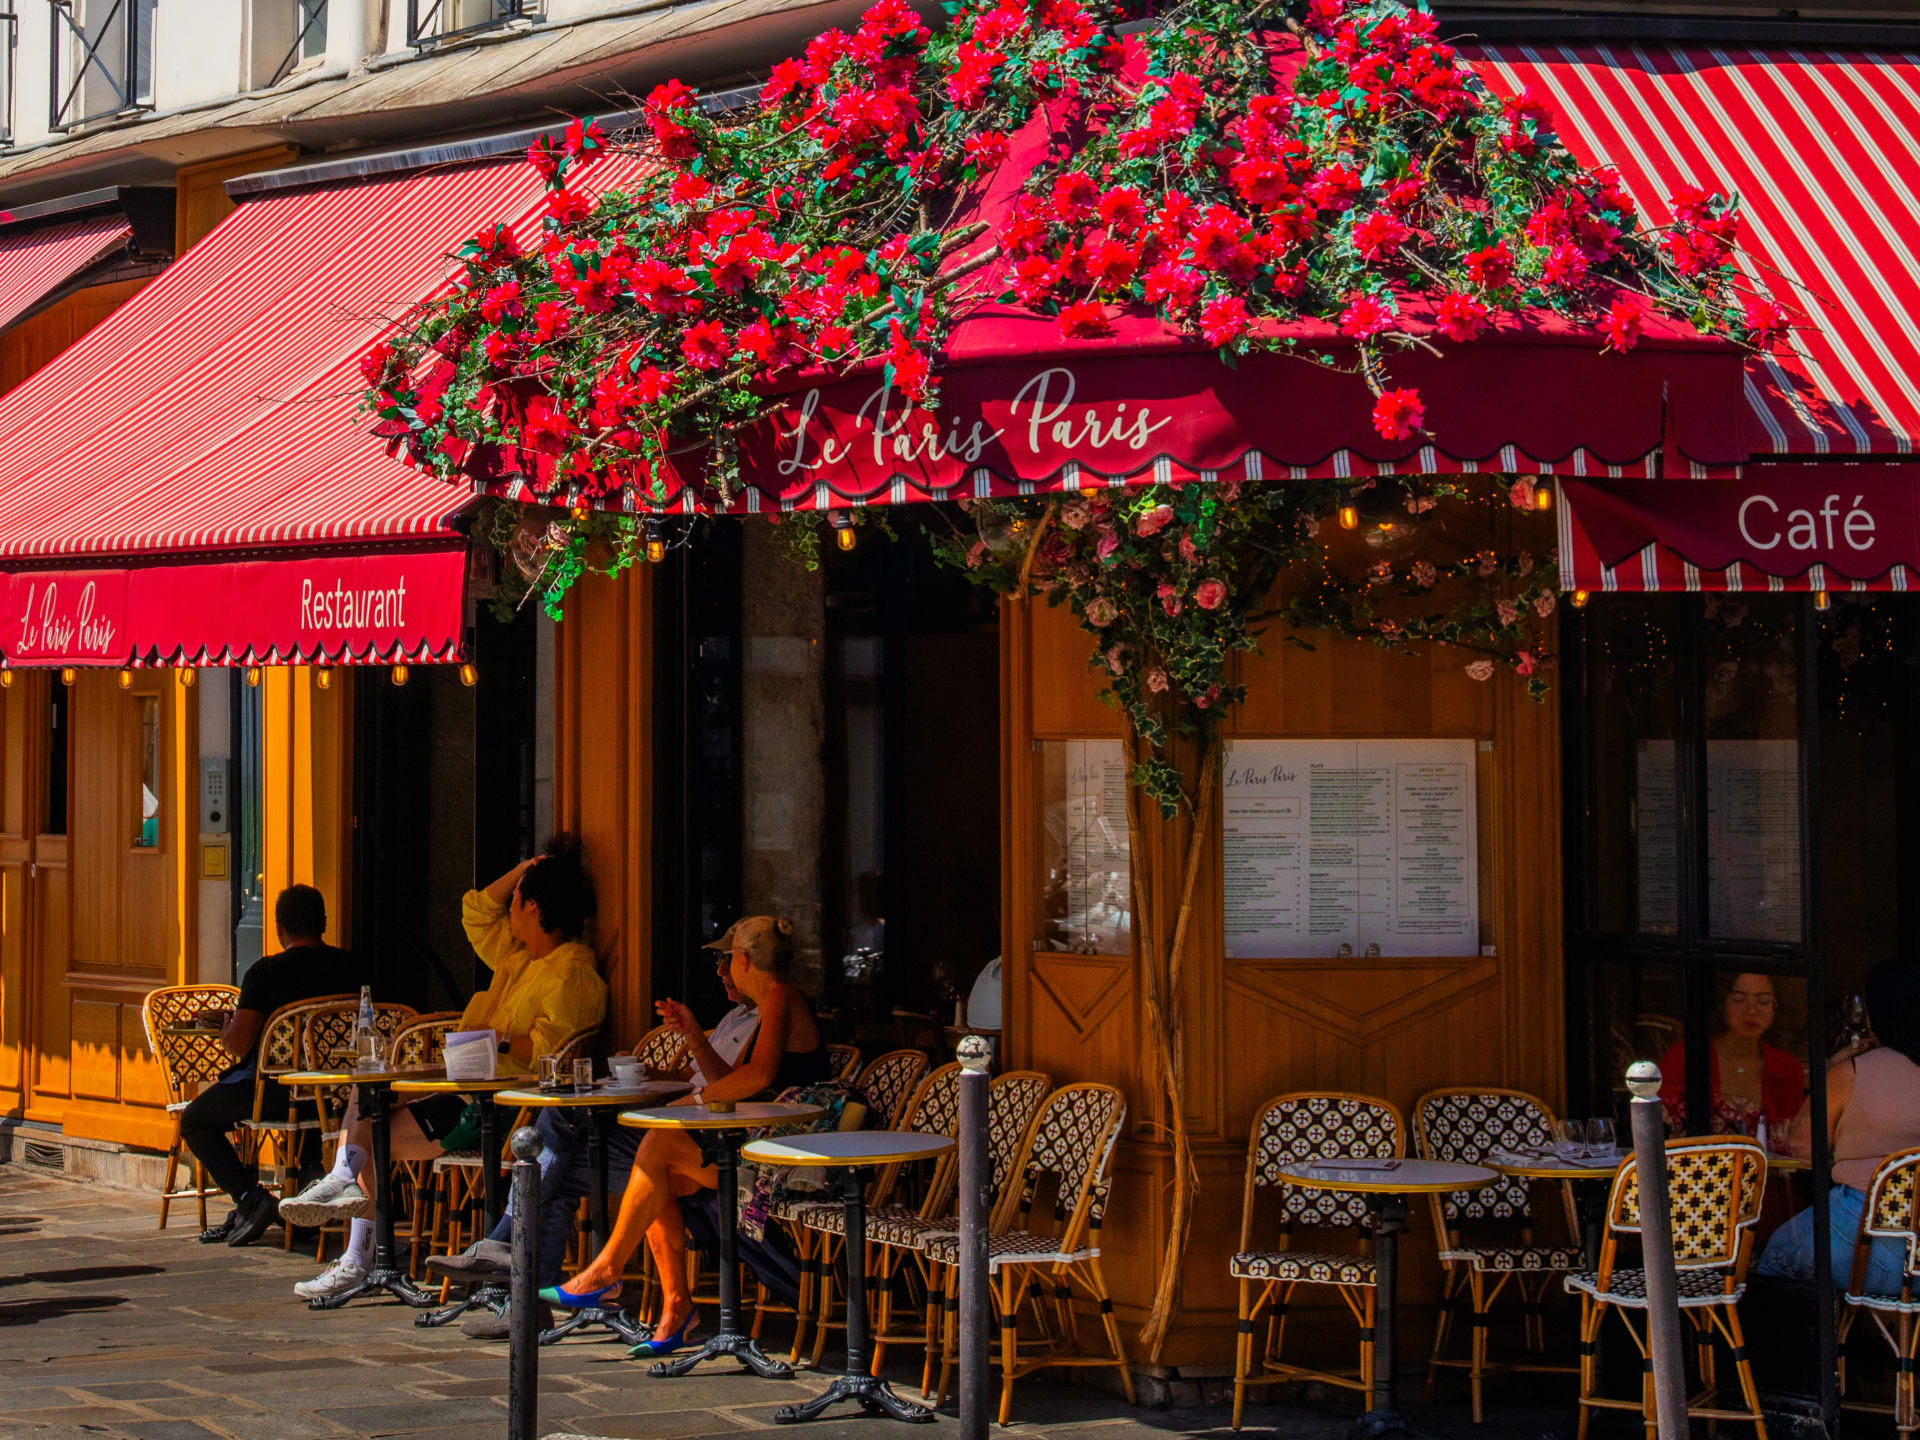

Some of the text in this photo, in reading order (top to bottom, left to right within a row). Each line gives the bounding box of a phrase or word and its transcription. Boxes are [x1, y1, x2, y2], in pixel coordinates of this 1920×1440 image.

[777, 367, 1173, 476] Le Paris Paris
[1738, 494, 1876, 551] Café
[16, 580, 116, 656] Le Paris Paris
[300, 574, 406, 630] Restaurant
[1225, 764, 1298, 788] Le Paris Paris
